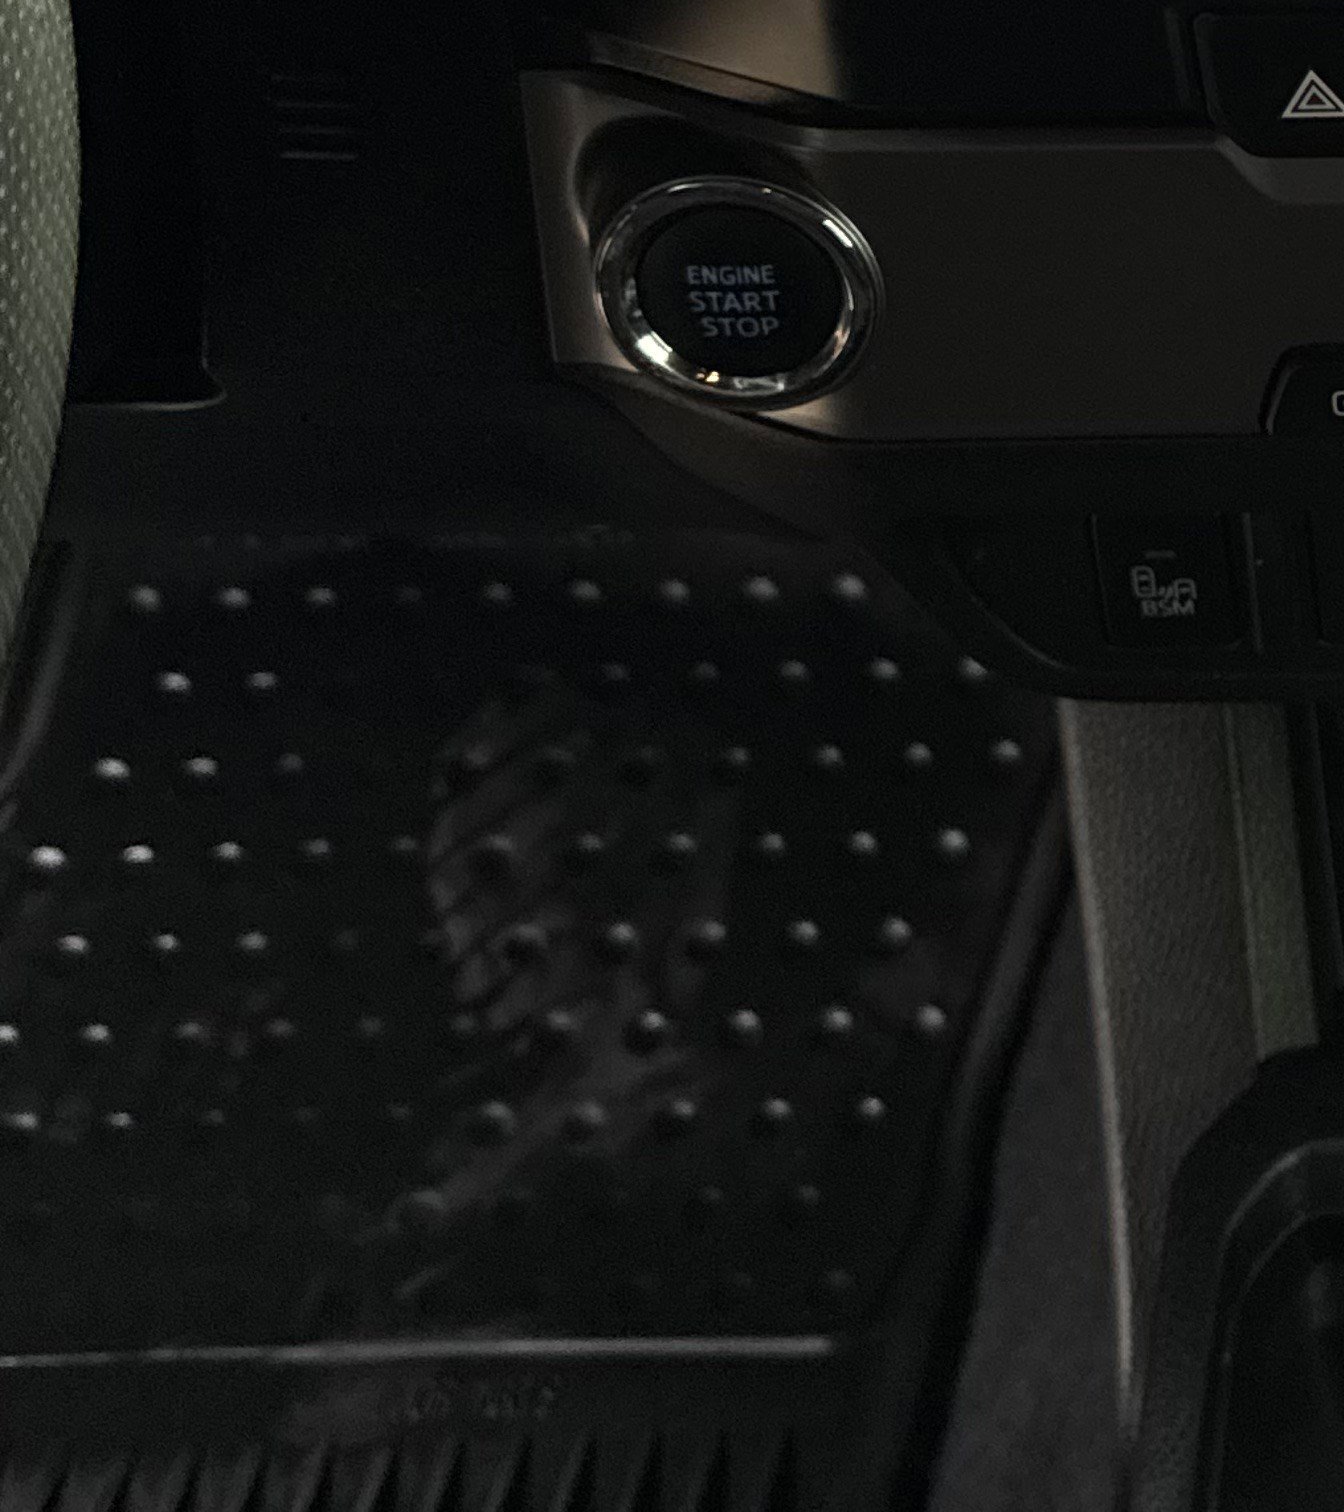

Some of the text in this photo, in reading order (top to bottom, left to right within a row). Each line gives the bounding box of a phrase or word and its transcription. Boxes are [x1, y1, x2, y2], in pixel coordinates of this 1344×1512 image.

[687, 264, 774, 285] ENGINE
[689, 290, 779, 312] START
[700, 316, 779, 338] STOP
[1141, 598, 1197, 618] BSM
